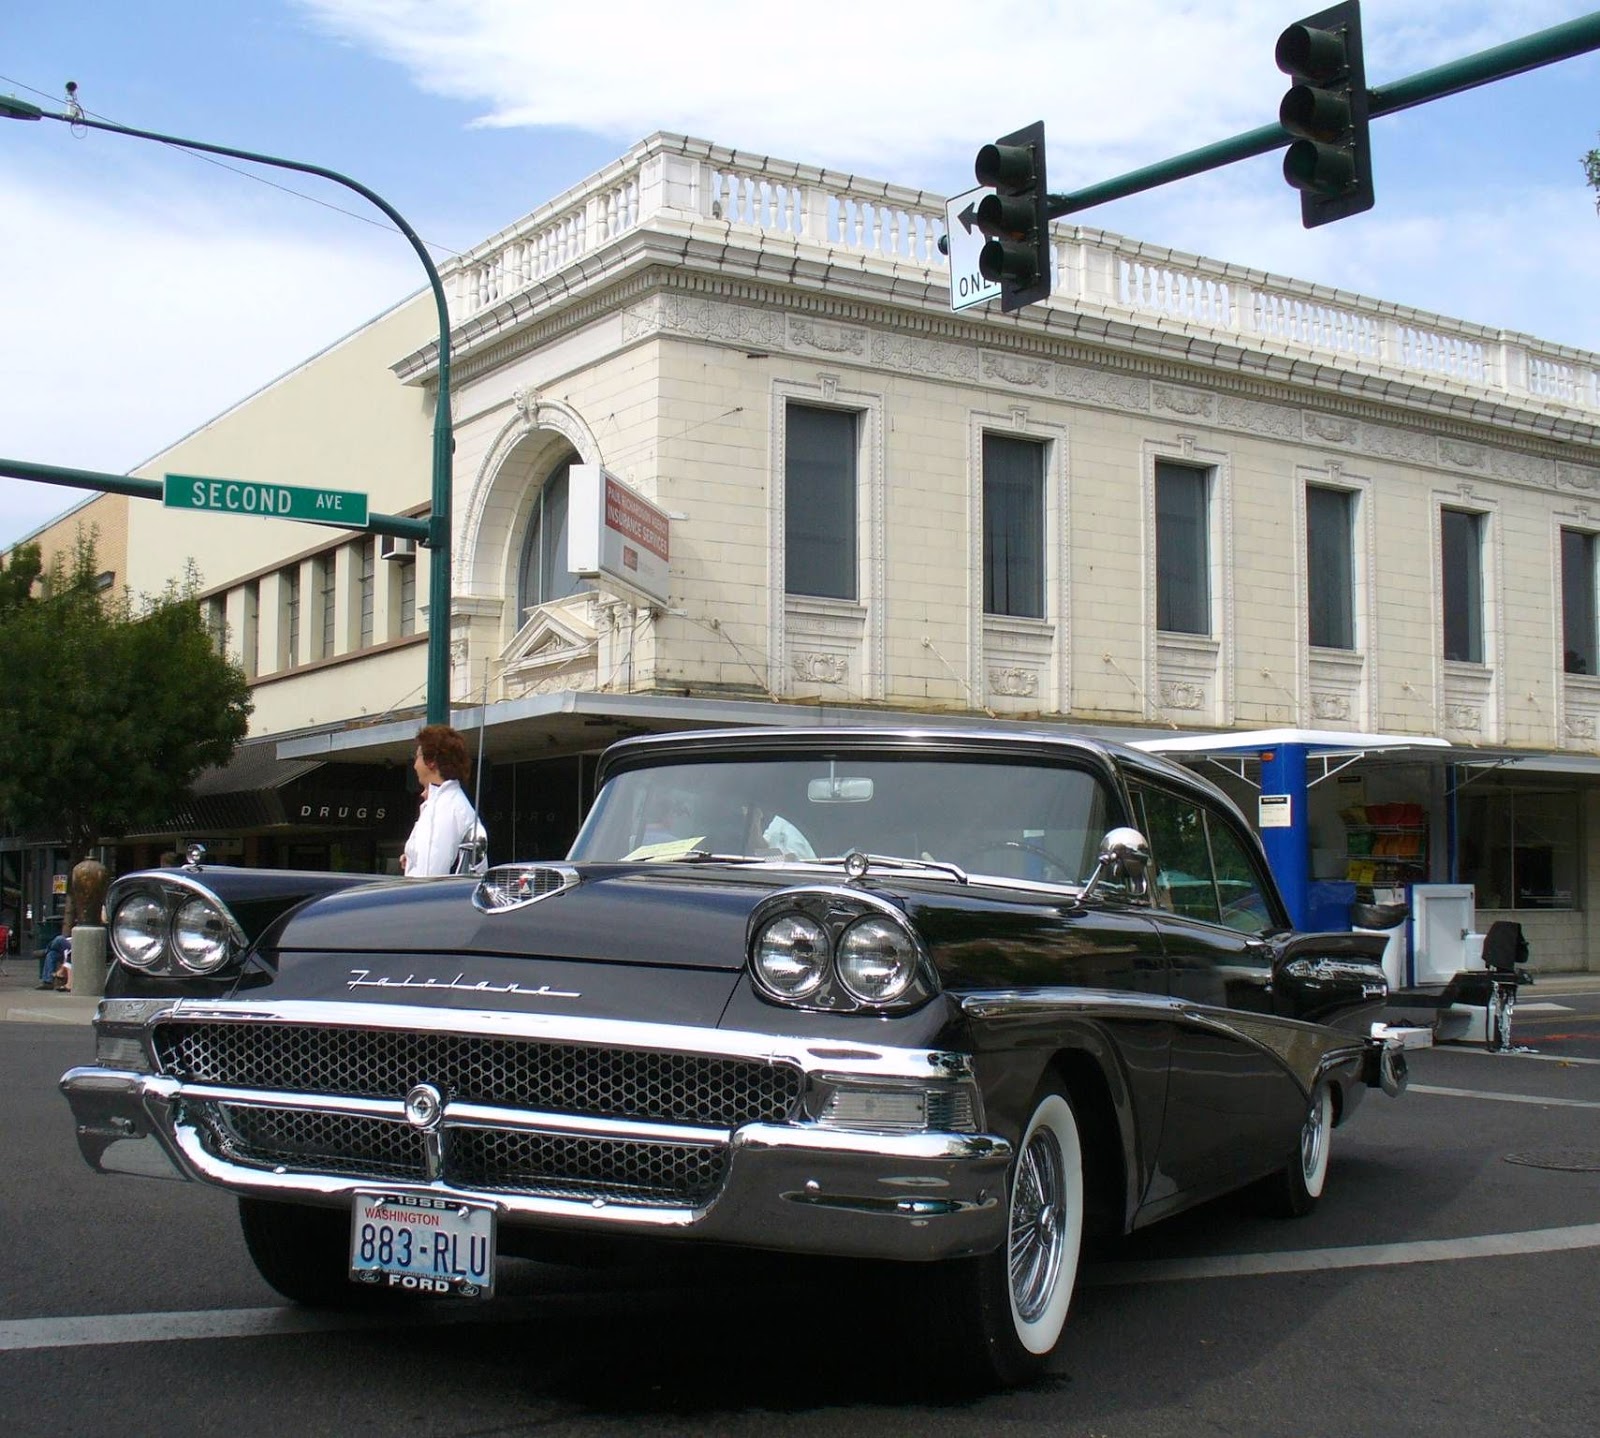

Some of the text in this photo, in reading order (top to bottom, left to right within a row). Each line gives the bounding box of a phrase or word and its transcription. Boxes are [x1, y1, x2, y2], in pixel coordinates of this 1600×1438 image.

[959, 272, 998, 298] ONL
[191, 481, 343, 513] SECOND AVE
[607, 505, 642, 538] INSURANCE
[642, 526, 668, 554] SERVICES
[300, 805, 386, 819] DRUGS
[347, 969, 582, 997] Fairlane
[364, 1207, 441, 1227] WASHINGTON
[360, 1223, 486, 1277] 883-RLU
[388, 1274, 450, 1293] FORD
